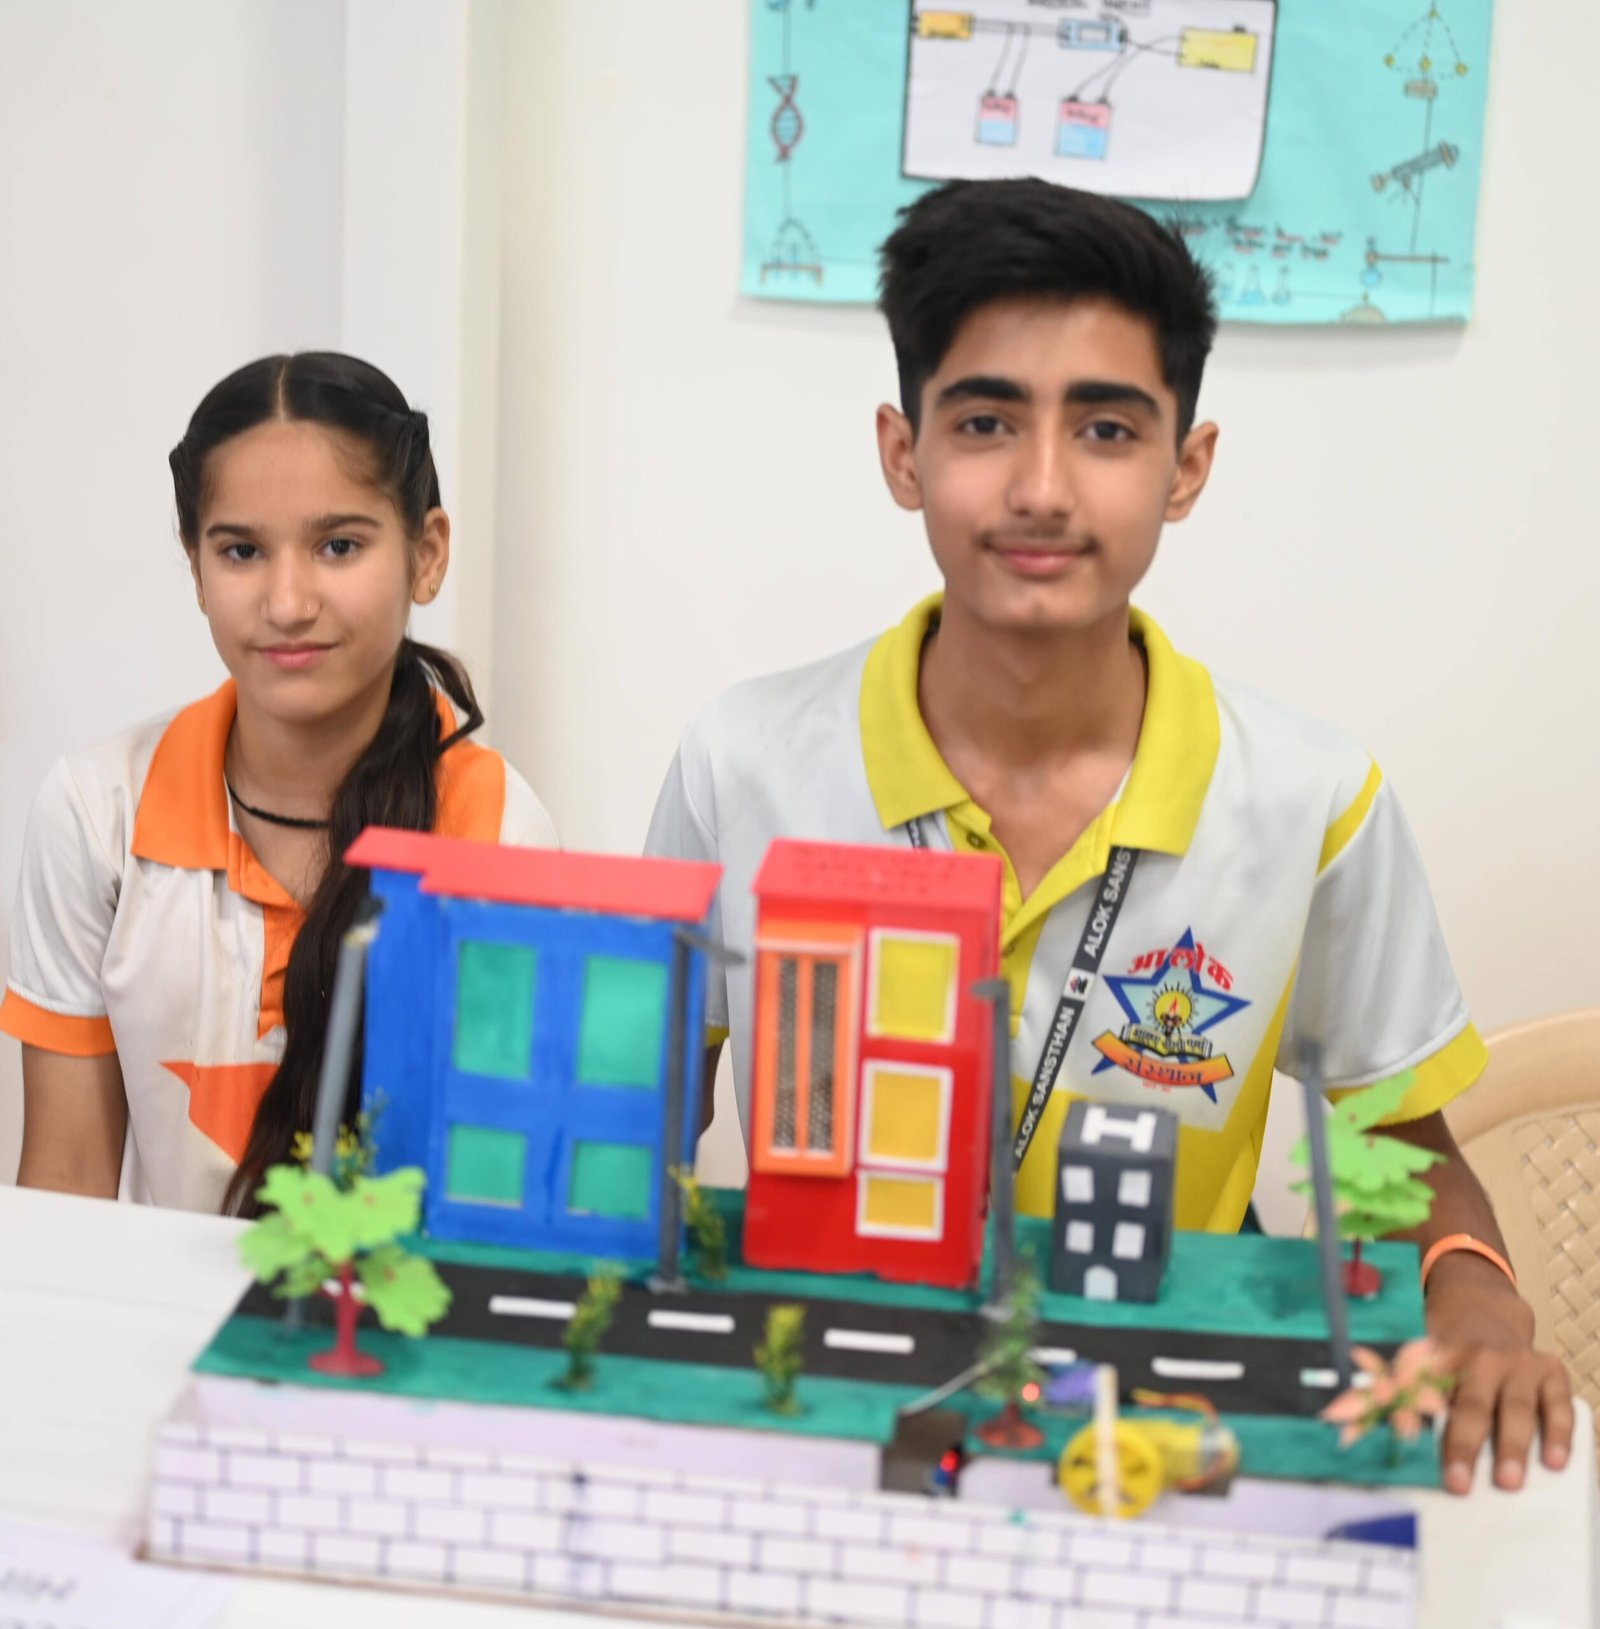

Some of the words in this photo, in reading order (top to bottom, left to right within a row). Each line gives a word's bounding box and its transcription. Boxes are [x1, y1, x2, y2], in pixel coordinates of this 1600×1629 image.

[1083, 903, 1113, 959] ALOK
[1127, 942, 1234, 991] आलोक
[1015, 1108, 1039, 1159] ALOK
[1032, 1005, 1075, 1106] SANSTHAN
